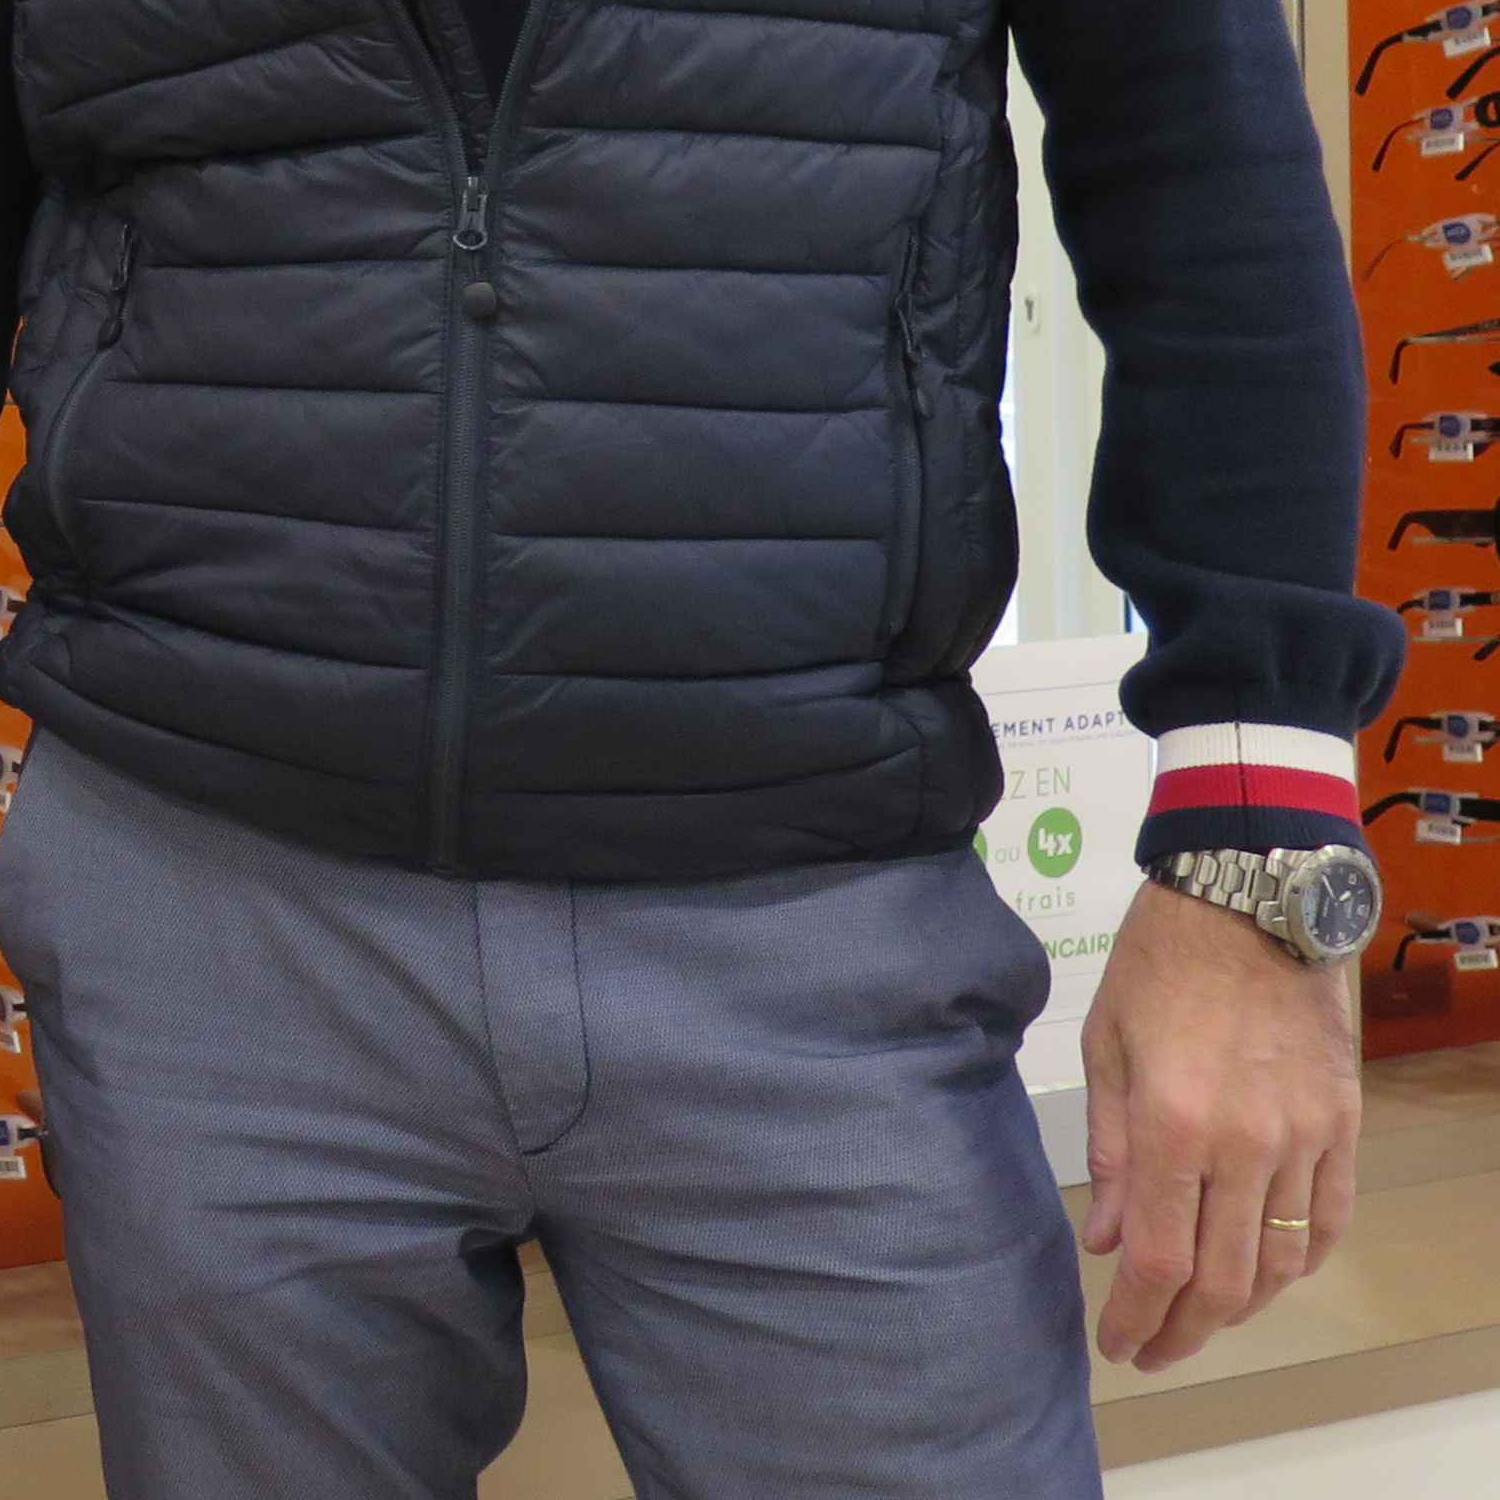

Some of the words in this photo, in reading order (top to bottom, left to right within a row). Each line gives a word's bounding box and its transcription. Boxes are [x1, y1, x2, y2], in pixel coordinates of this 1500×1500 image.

[990, 717, 1054, 740] EMENT
[1016, 886, 1076, 912] frais
[1045, 933, 1116, 960] NCAIR
